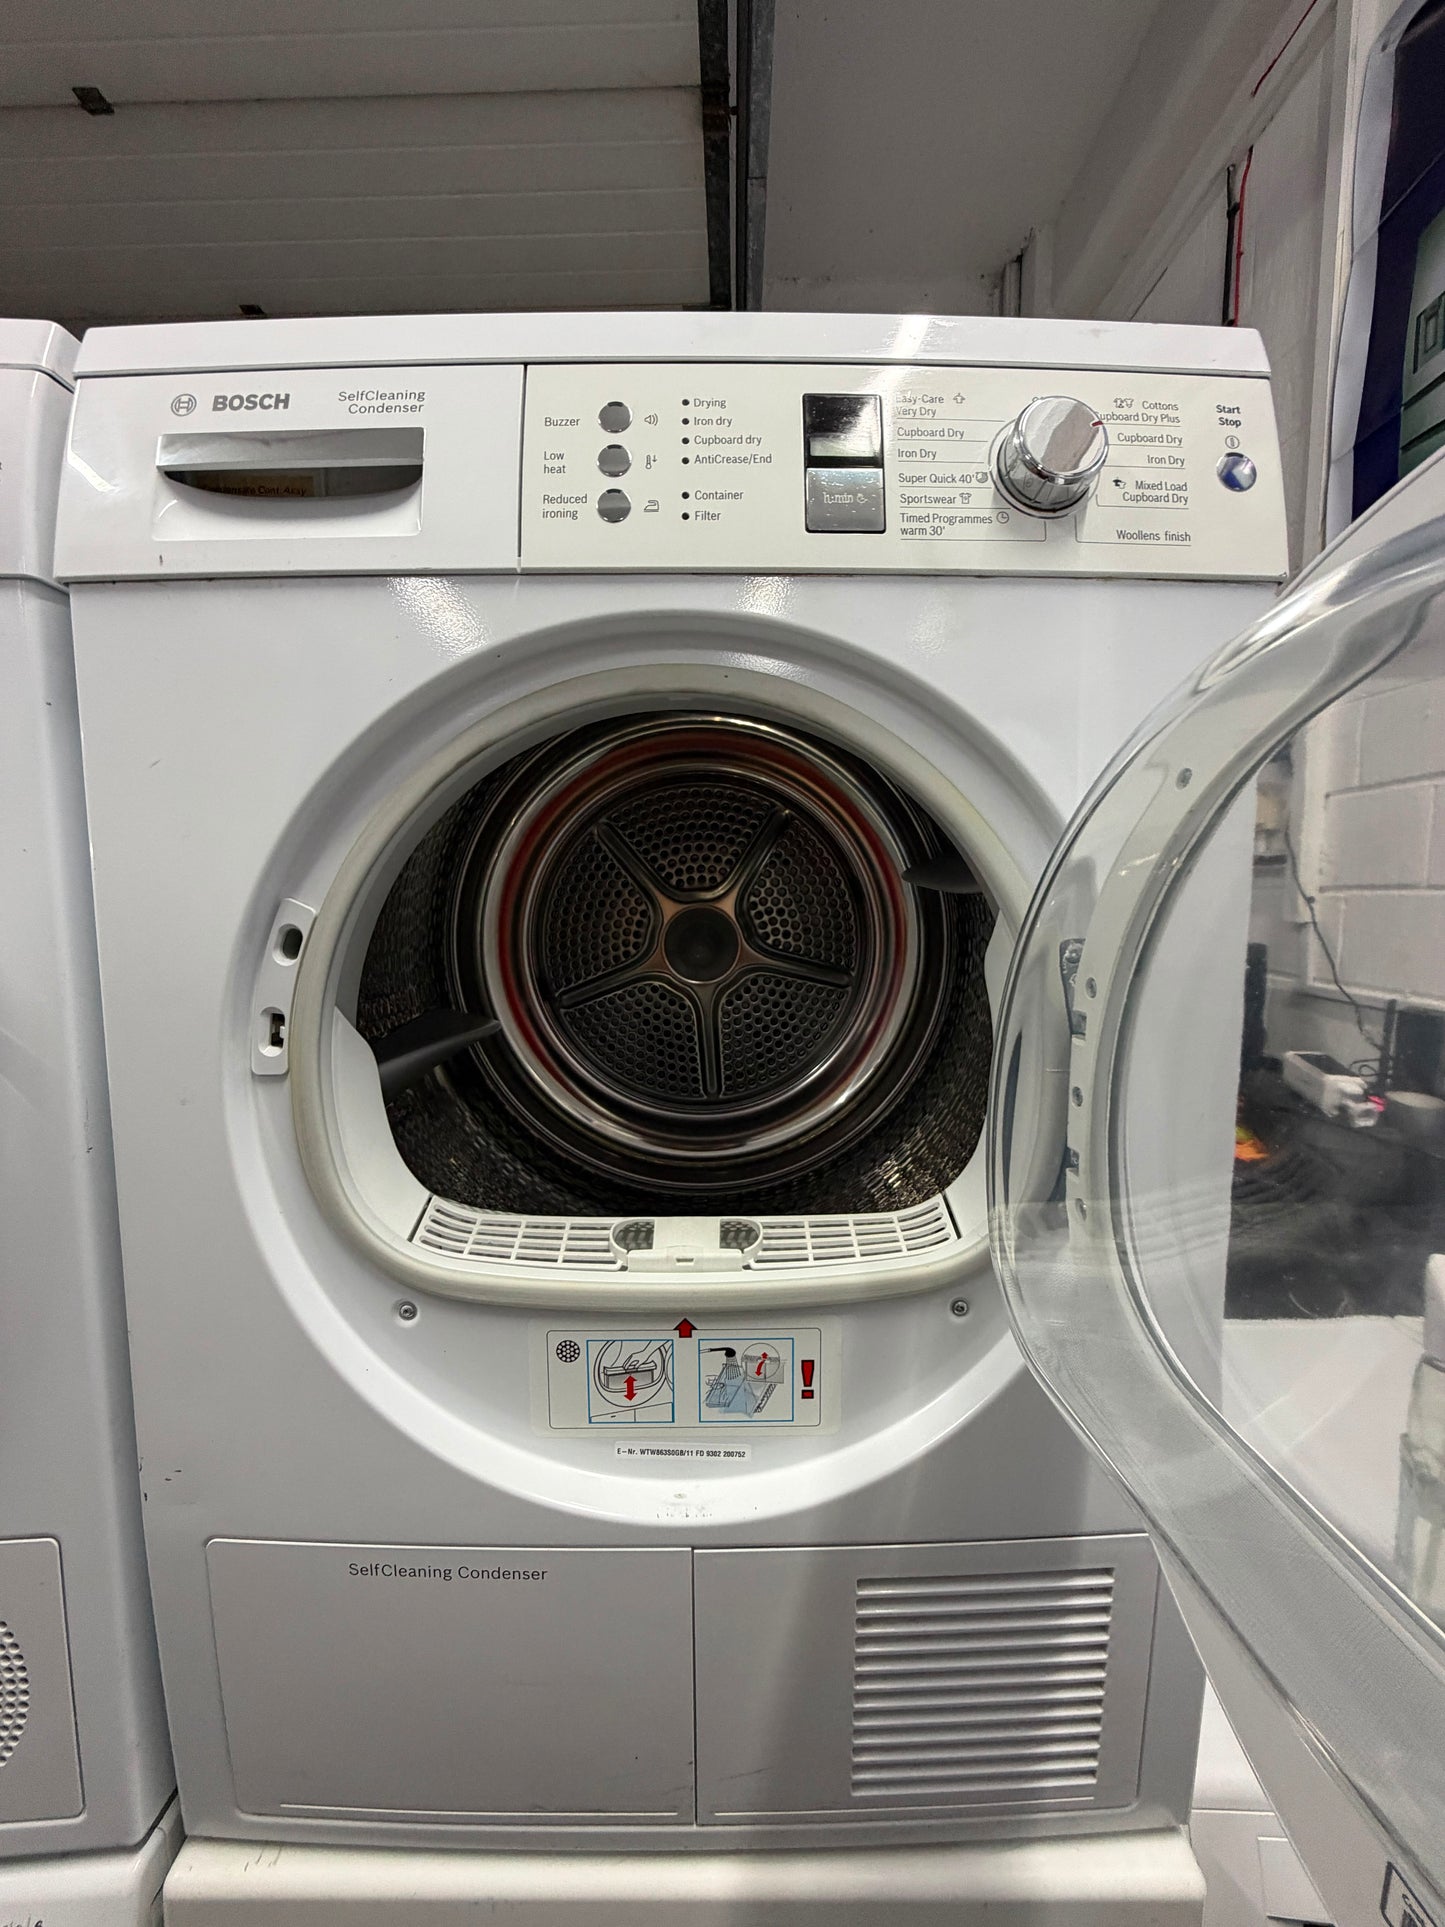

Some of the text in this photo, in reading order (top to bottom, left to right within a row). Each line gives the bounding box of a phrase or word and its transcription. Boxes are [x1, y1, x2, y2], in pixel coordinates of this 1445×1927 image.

[338, 390, 425, 402] SelfCleaning
[896, 395, 944, 405] Easy-Care
[212, 393, 290, 411] BOSCH
[694, 398, 726, 408] Drying
[1142, 401, 1179, 411] Cottons
[348, 403, 424, 414] Condenser
[897, 407, 936, 417] Very Dry
[1216, 405, 1241, 414] Start
[544, 417, 580, 426] Buzzer
[694, 417, 732, 427] Iron dry
[1141, 413, 1158, 424] Dry
[1161, 415, 1180, 423] Plus
[1219, 417, 1241, 427] Stop
[898, 428, 964, 439] Cupboard Dry
[694, 436, 762, 446] Cupboard dry
[1118, 433, 1183, 445] Cupboard Dry
[544, 451, 564, 461] Low
[694, 455, 772, 464] AntiCrease/End
[898, 449, 936, 460] Iron Dry
[1147, 455, 1185, 466] Iron Dry
[544, 465, 566, 473] heat
[899, 473, 975, 484] Super Quick 40'
[1136, 481, 1188, 491] Mixed Load
[543, 494, 587, 504] Reduced
[695, 491, 744, 500] Container
[900, 494, 957, 505] Sportswear
[1123, 492, 1188, 505] Cupboard Dry
[543, 509, 578, 520] ironing
[695, 512, 721, 520] Filter
[900, 513, 992, 525] Timed Programmes
[901, 526, 945, 536] warm 30'
[1117, 530, 1191, 542] Woollens finish
[349, 1563, 548, 1581] SelfCleaning Condenser
